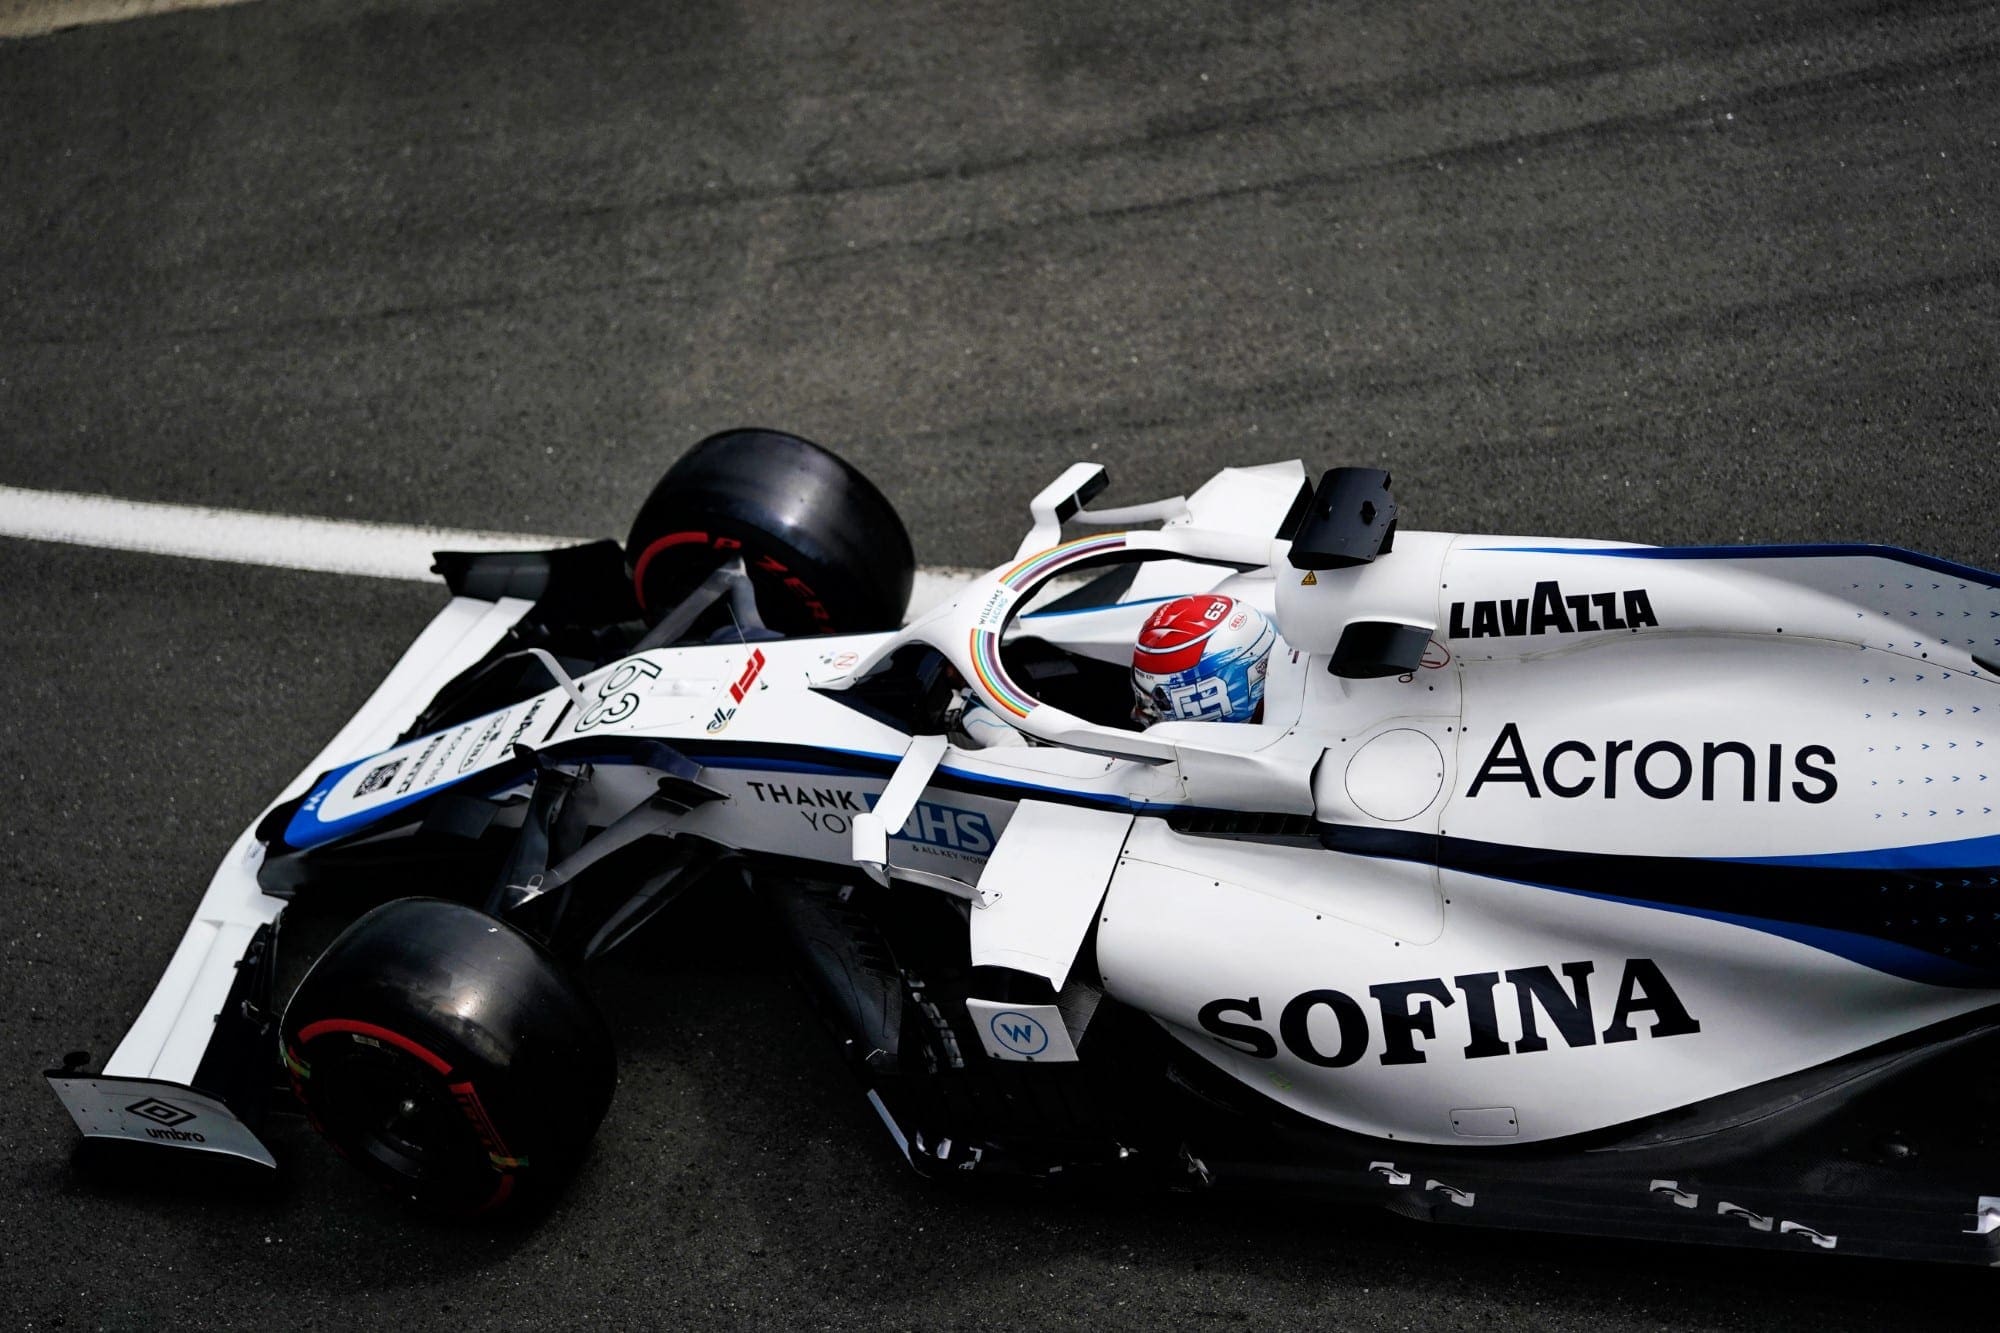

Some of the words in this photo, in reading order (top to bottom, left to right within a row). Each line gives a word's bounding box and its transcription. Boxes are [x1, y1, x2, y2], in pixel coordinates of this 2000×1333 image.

[979, 589, 1003, 625] WILLIAMS
[990, 598, 1008, 624] RACING
[1203, 602, 1227, 620] 63
[1448, 581, 1659, 639] LAVAZZA
[729, 648, 765, 704] F1
[574, 658, 663, 732] 63
[1465, 722, 1839, 804] Acronis
[747, 781, 861, 812] THANK
[801, 811, 853, 834] YO
[922, 847, 939, 856] ALL
[941, 849, 958, 860] KEY
[1197, 958, 1701, 1068] SOFINA
[145, 1127, 206, 1144] umbro
